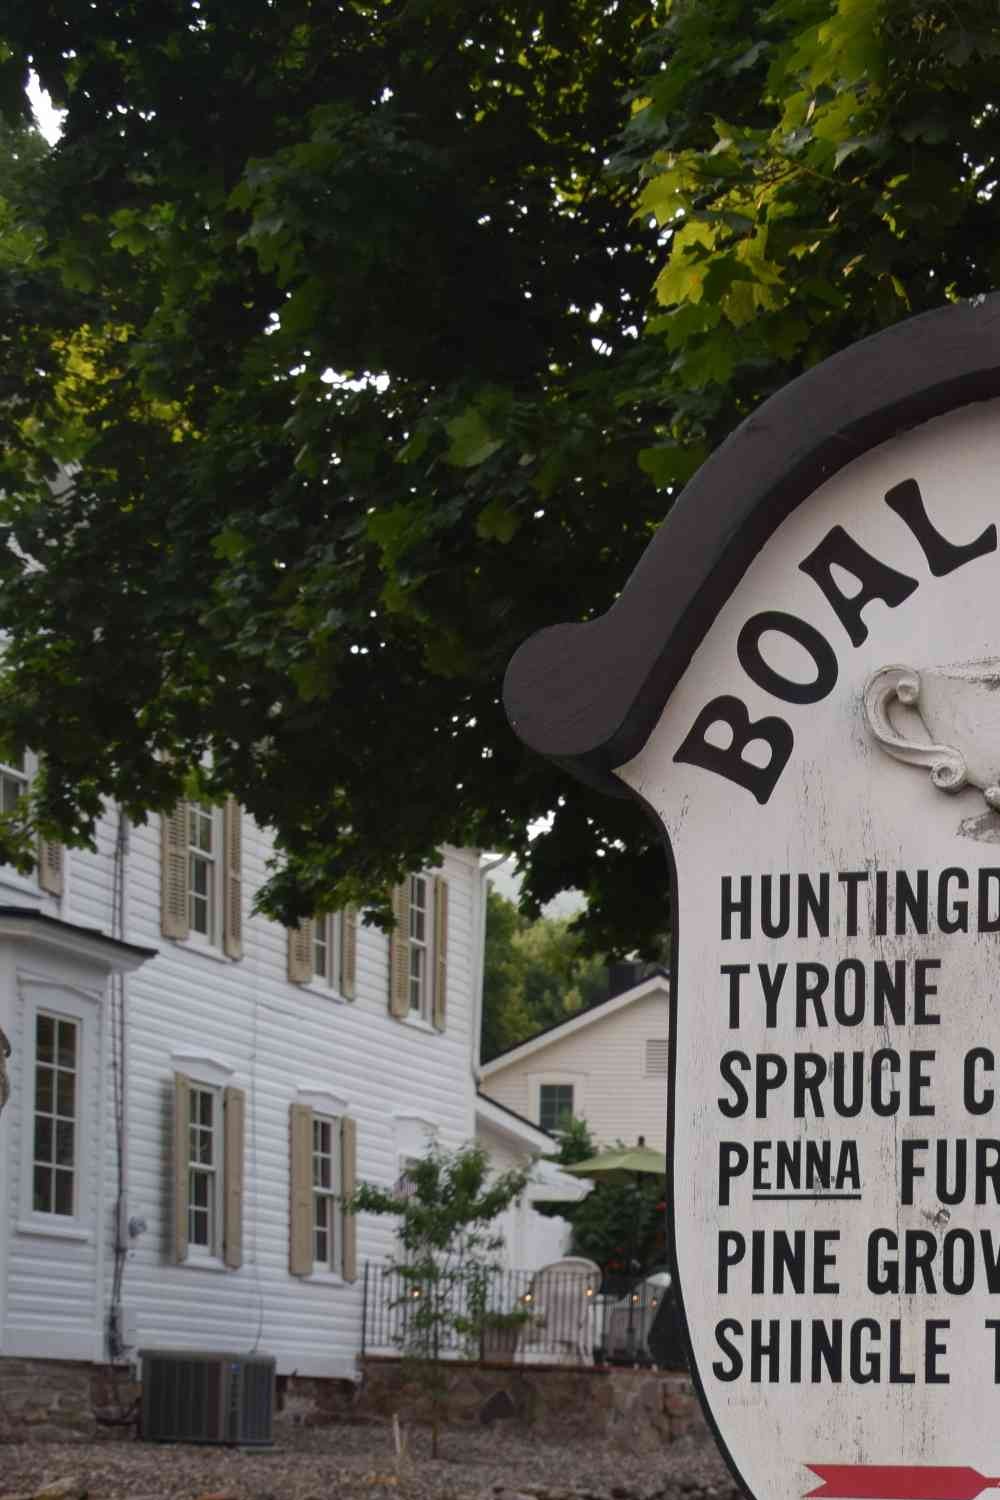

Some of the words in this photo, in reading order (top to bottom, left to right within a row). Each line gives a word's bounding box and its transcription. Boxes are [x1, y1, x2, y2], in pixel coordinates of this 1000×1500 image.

[720, 958, 941, 1029] TYRONE
[717, 1047, 936, 1118] SPRUCE
[718, 1140, 862, 1206] PENNA
[717, 1230, 841, 1295] PINE
[712, 1318, 951, 1385] SHINGLE
